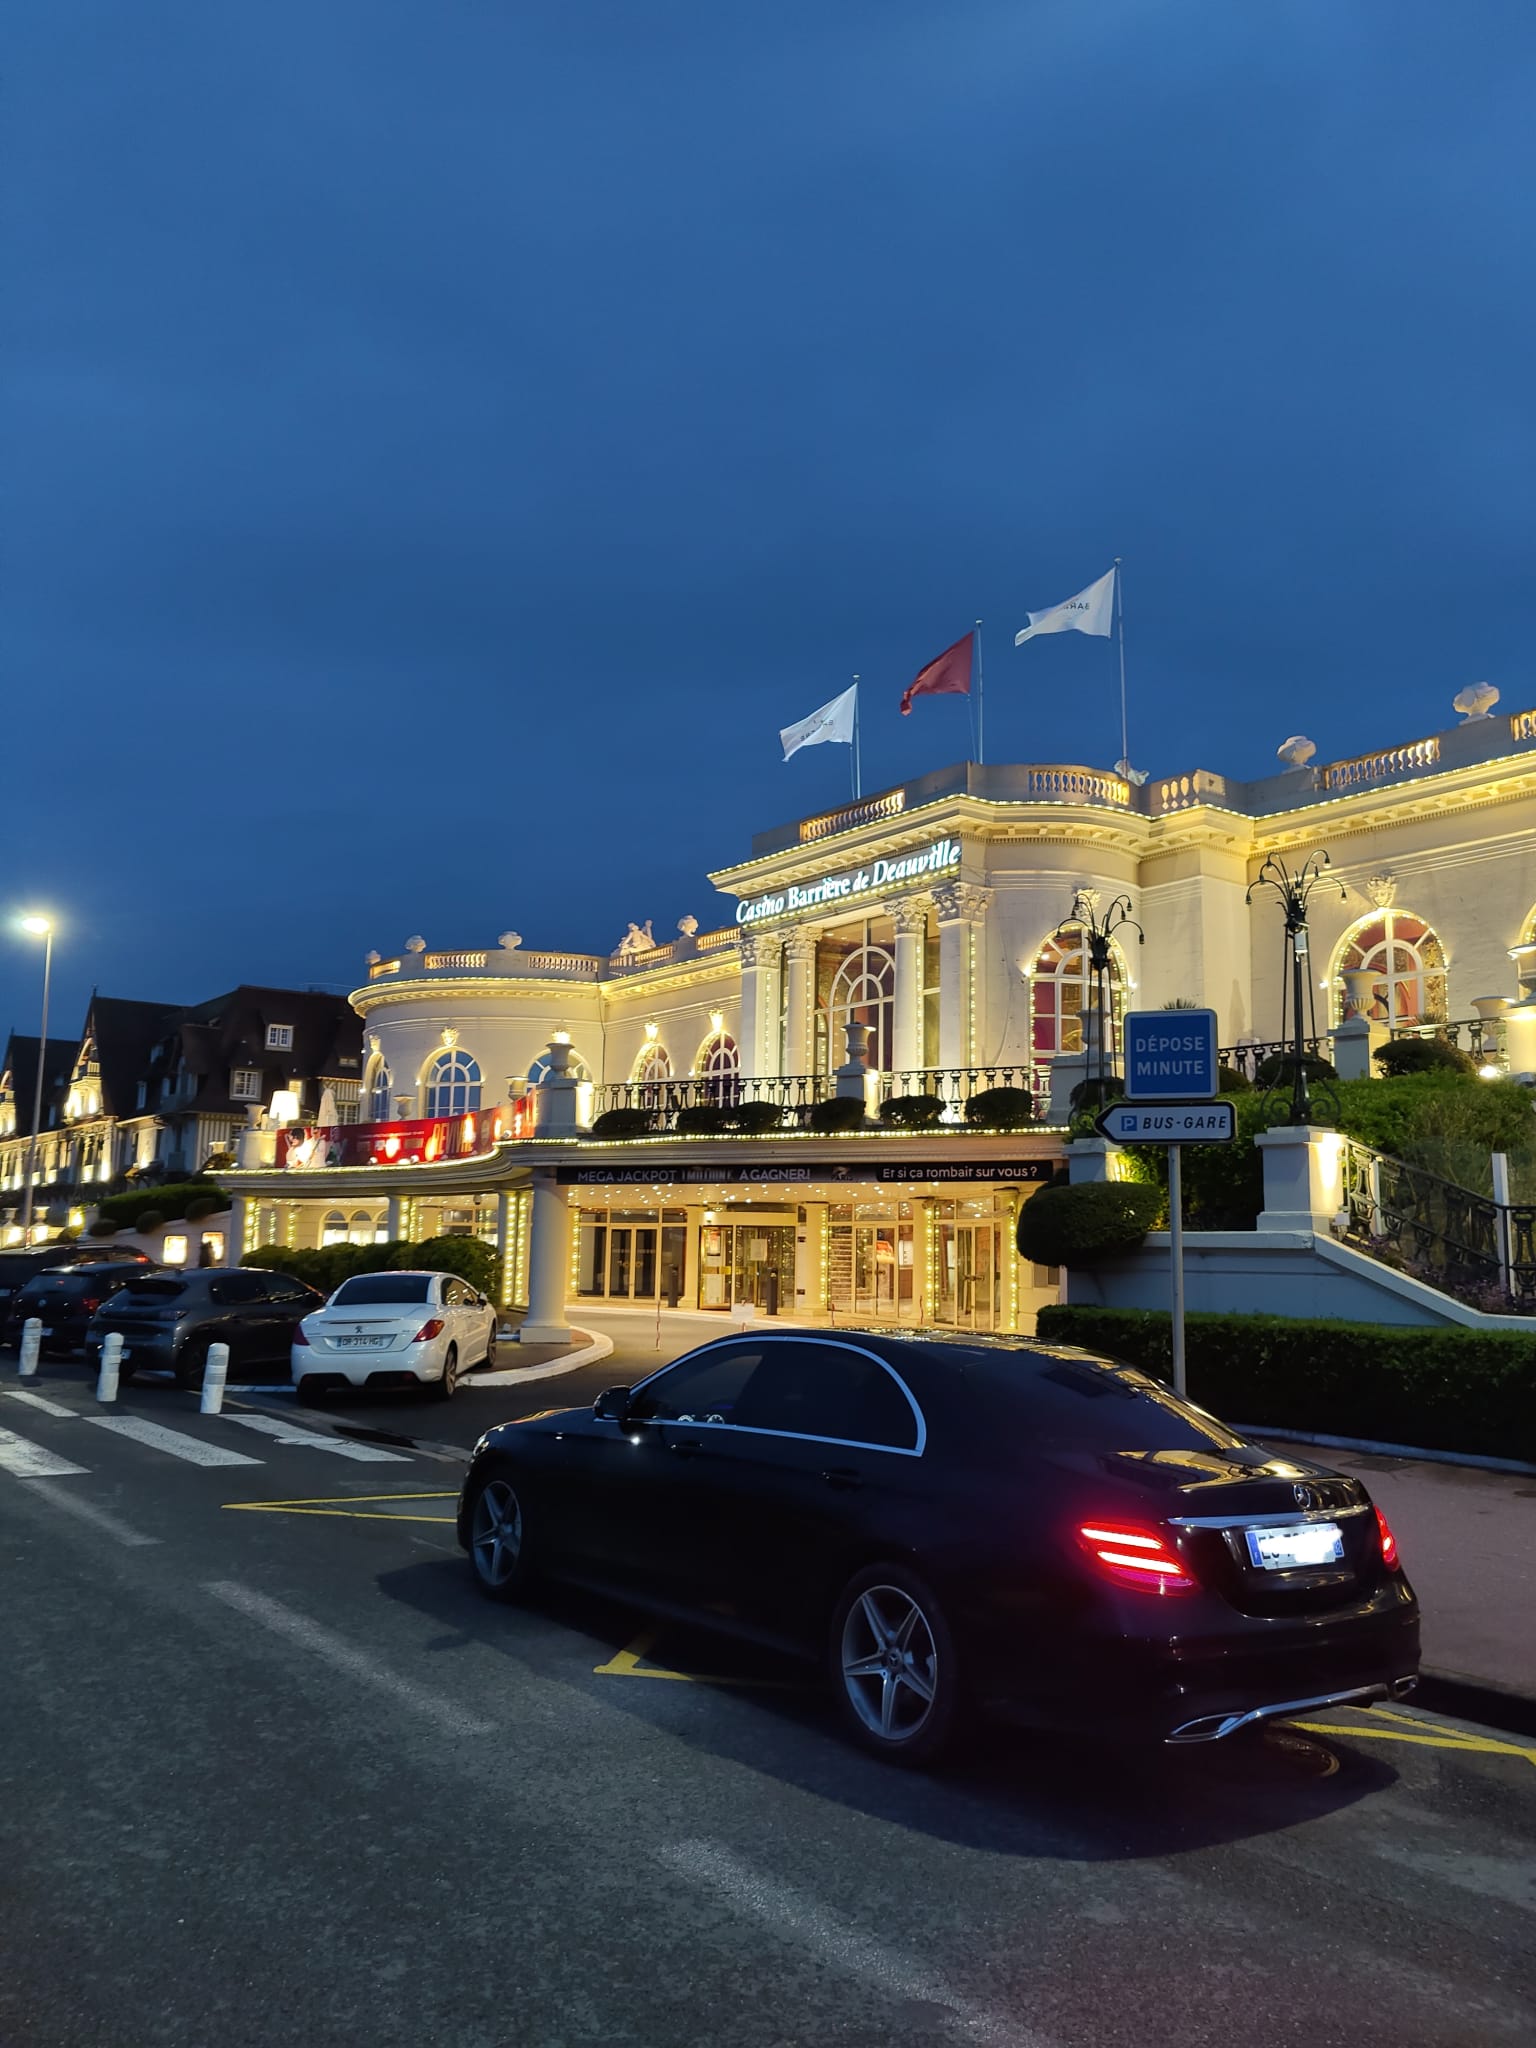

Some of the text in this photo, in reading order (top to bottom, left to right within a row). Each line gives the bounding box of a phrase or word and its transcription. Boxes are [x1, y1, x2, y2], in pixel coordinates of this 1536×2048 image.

[735, 839, 962, 924] Casino Barrière de Deauville
[1136, 1034, 1205, 1053] DÉPOSE
[1137, 1060, 1205, 1076] MINUTE
[1143, 1116, 1227, 1129] BUS-GARE
[577, 1170, 614, 1182] MEGA
[616, 1169, 677, 1182] JACKPOT
[897, 1166, 907, 1178] si
[909, 1169, 923, 1180] ça
[975, 1167, 995, 1178] sur
[997, 1167, 1028, 1177] vous
[1030, 1165, 1038, 1177] ?
